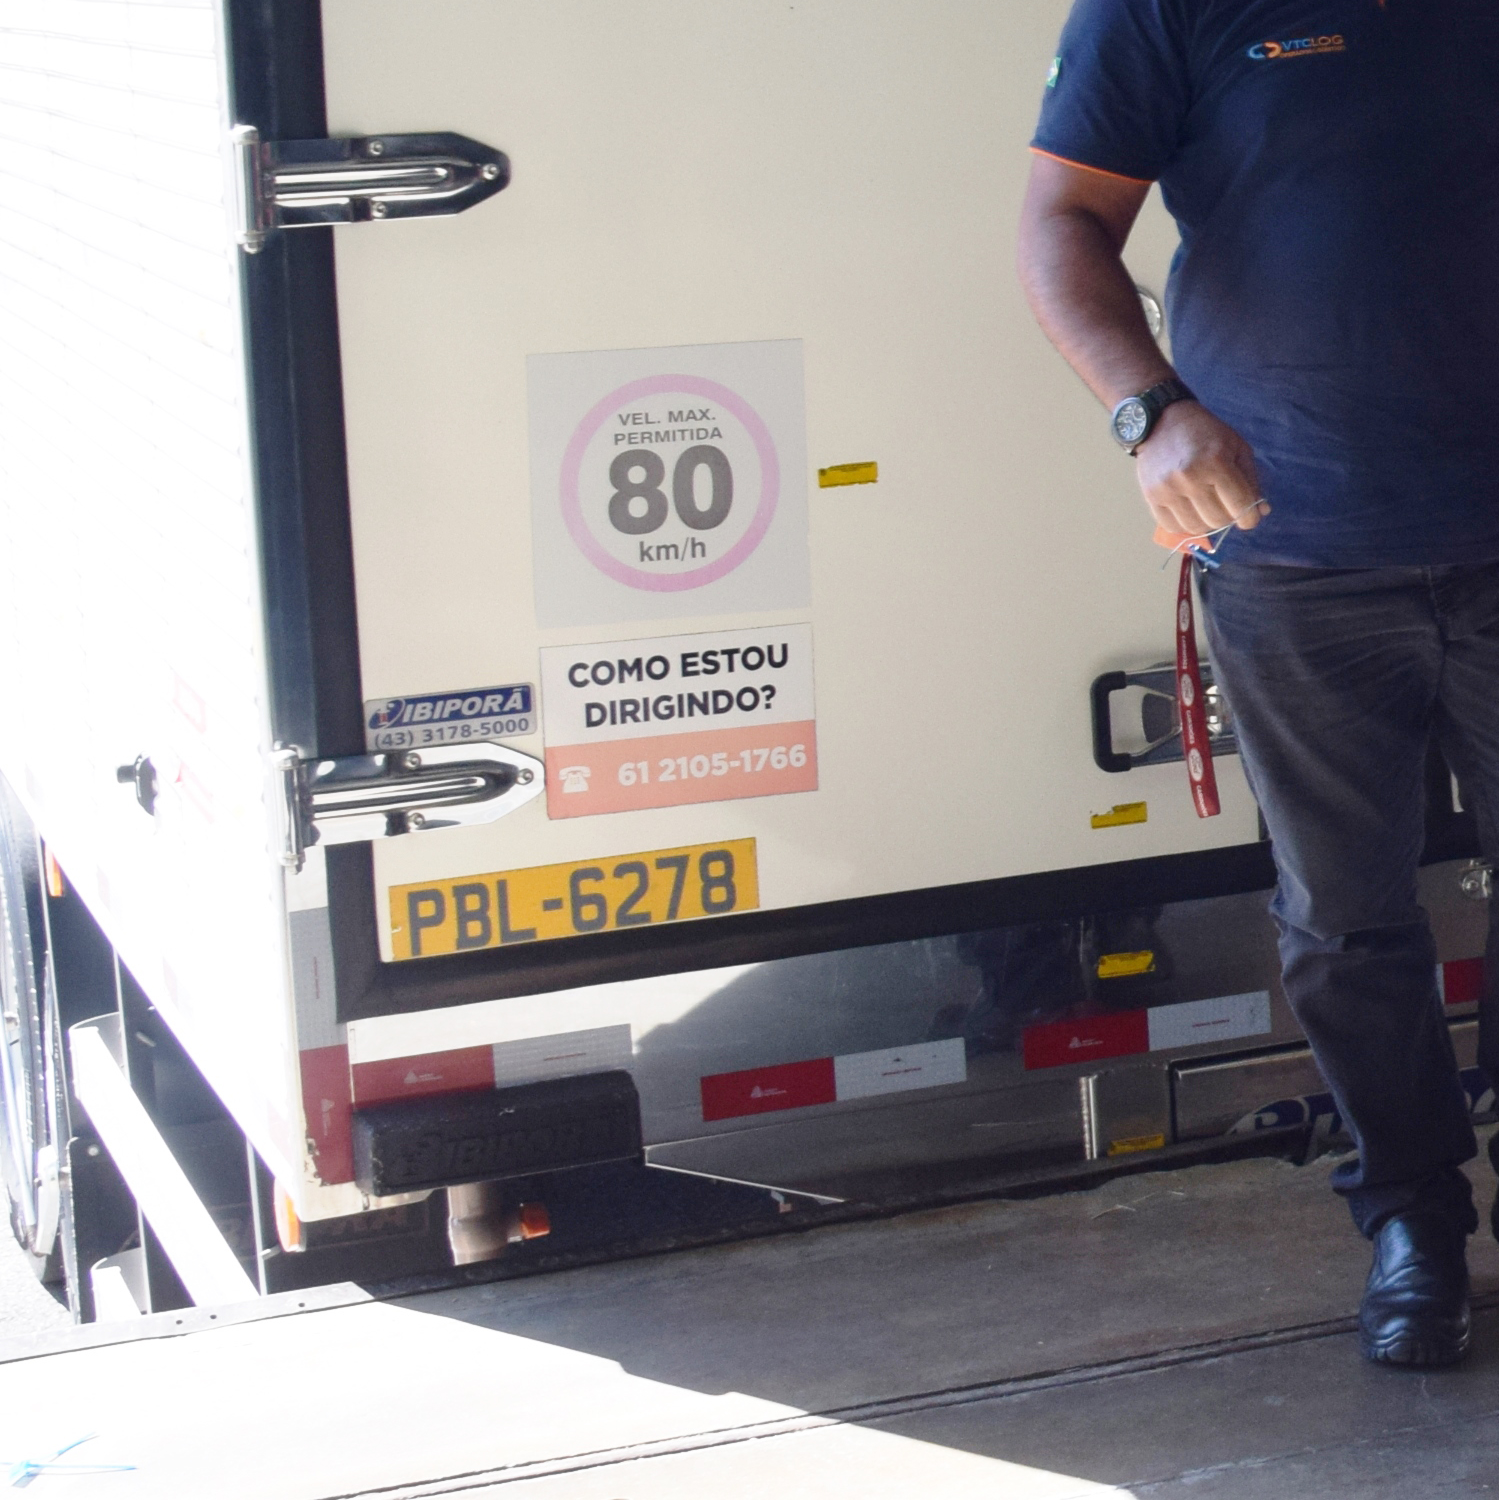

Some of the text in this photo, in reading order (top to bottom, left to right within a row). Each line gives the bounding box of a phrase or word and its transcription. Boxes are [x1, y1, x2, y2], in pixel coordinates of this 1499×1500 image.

[1281, 34, 1345, 51] VTCLOG
[614, 426, 724, 446] PERMITIDA
[618, 408, 716, 427] VEL. MAX.
[608, 444, 735, 536] 80
[639, 537, 707, 563] km/h
[568, 643, 789, 688] COMO ESTOU
[402, 687, 524, 724] IBIPORÃ
[585, 684, 777, 729] DIRIGINDO?
[374, 717, 530, 751] (43) 3178-5000
[618, 744, 808, 787] 61 2105-1766
[406, 849, 738, 957] PBL-6278
